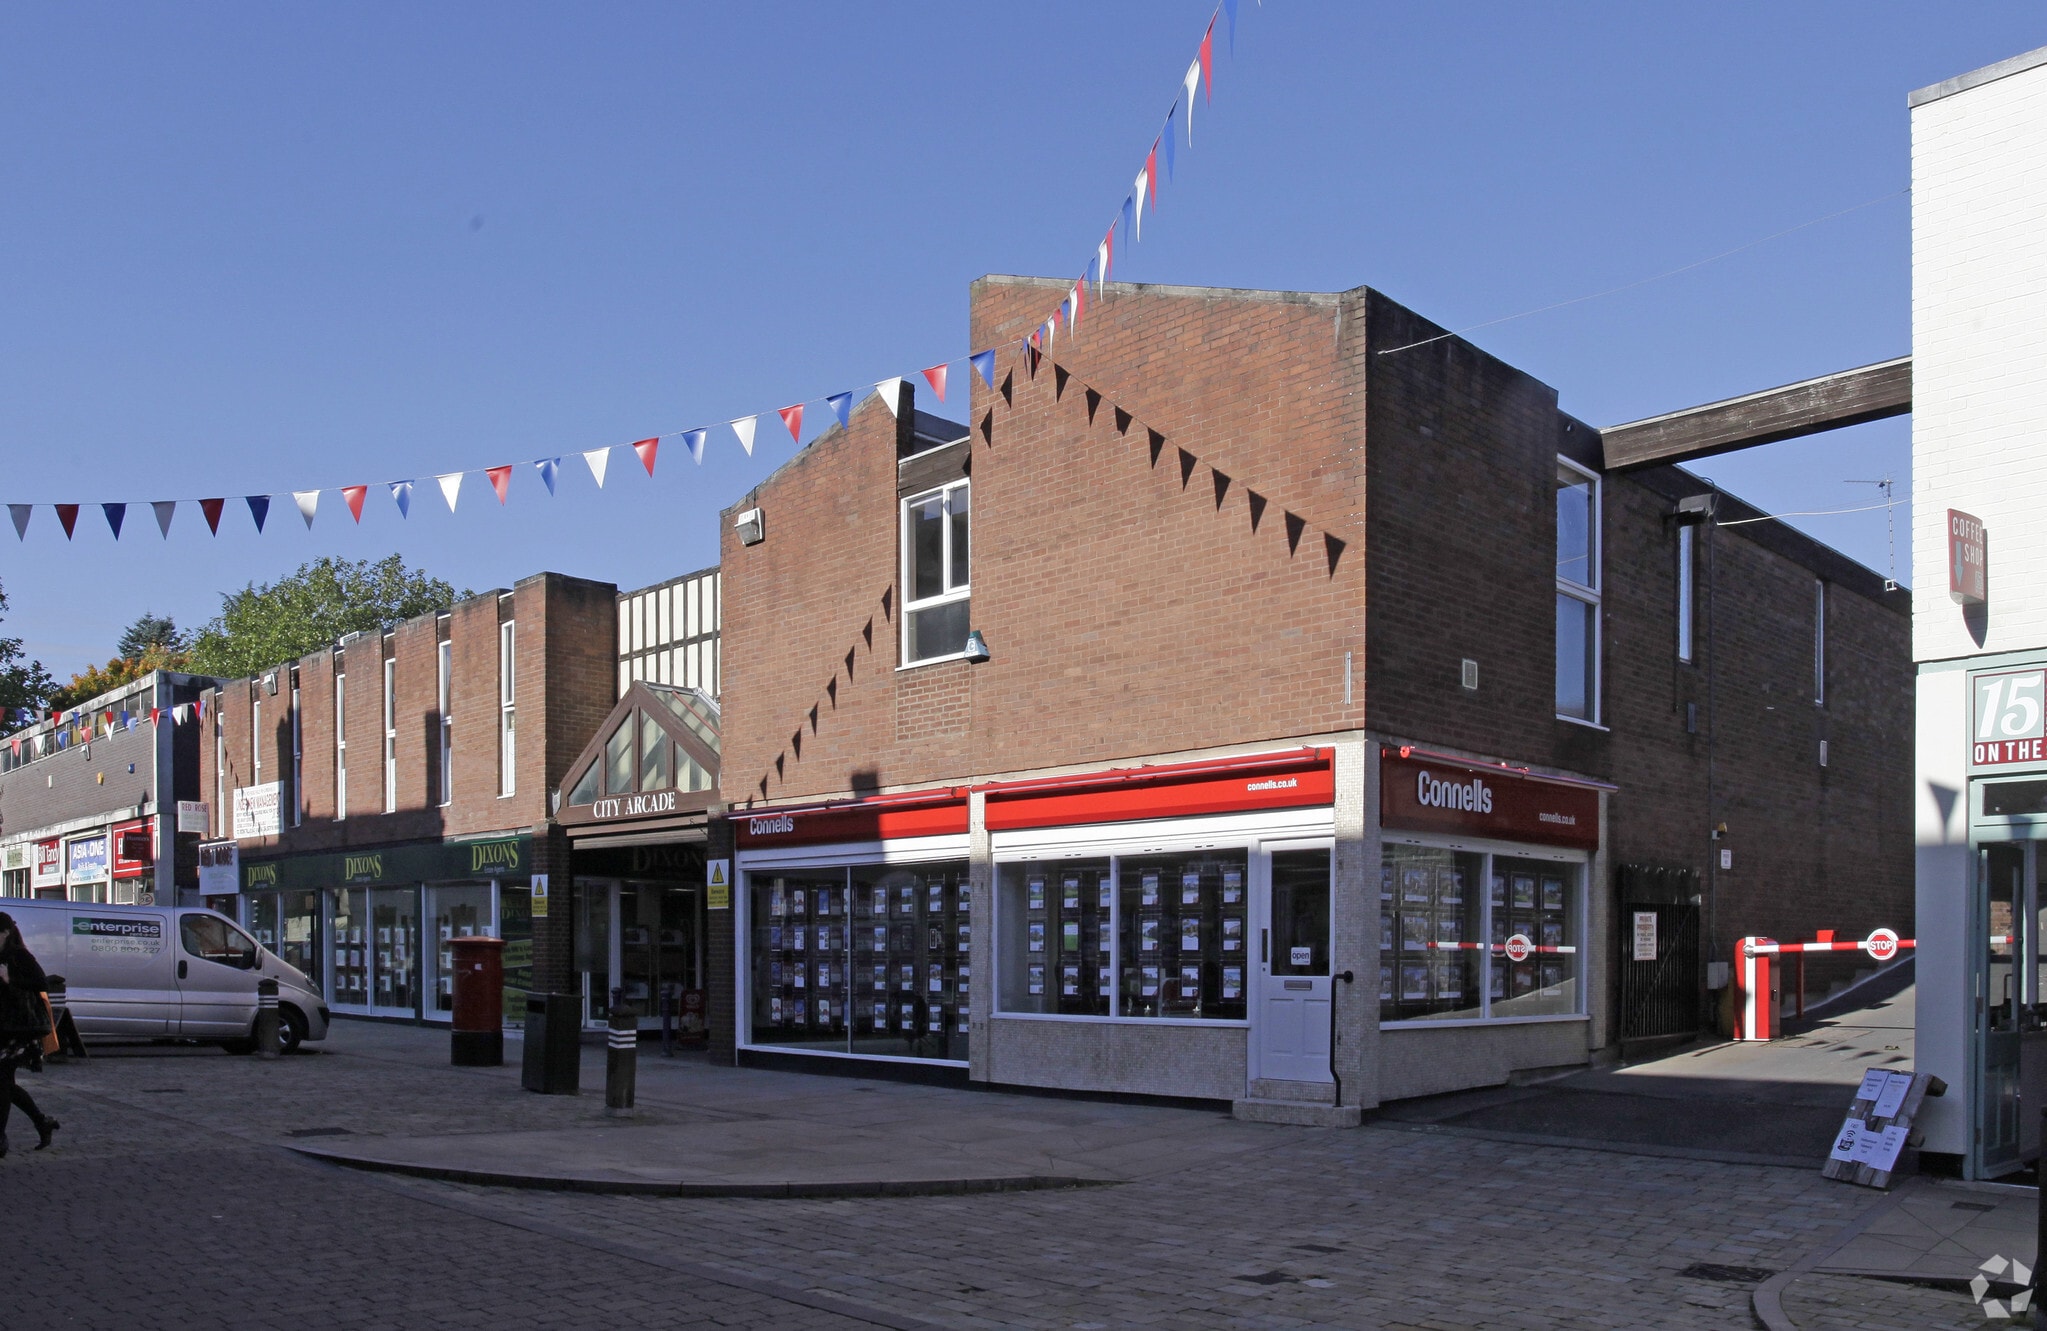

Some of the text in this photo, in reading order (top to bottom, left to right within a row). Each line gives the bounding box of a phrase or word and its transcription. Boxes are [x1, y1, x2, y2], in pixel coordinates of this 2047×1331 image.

[1952, 516, 1983, 545] COFFEE
[1964, 543, 1983, 567] SHOP
[1979, 674, 2042, 738] 15
[1975, 740, 2042, 763] ON THE
[1247, 777, 1298, 791] connells.co.uk
[1418, 770, 1492, 814] Connells
[182, 803, 207, 813] RED ROSE
[593, 791, 676, 818] CITY ARCADE
[750, 815, 794, 835] Connells
[1539, 812, 1576, 826] connells.co.uk
[345, 854, 382, 880] DIXONS
[471, 841, 519, 871] DIXONS
[247, 864, 276, 887] DIXONS
[77, 921, 160, 935] enterprise
[91, 938, 160, 946] enterprise.co.uk
[1870, 940, 1893, 951] STOP
[1291, 952, 1310, 960] open
